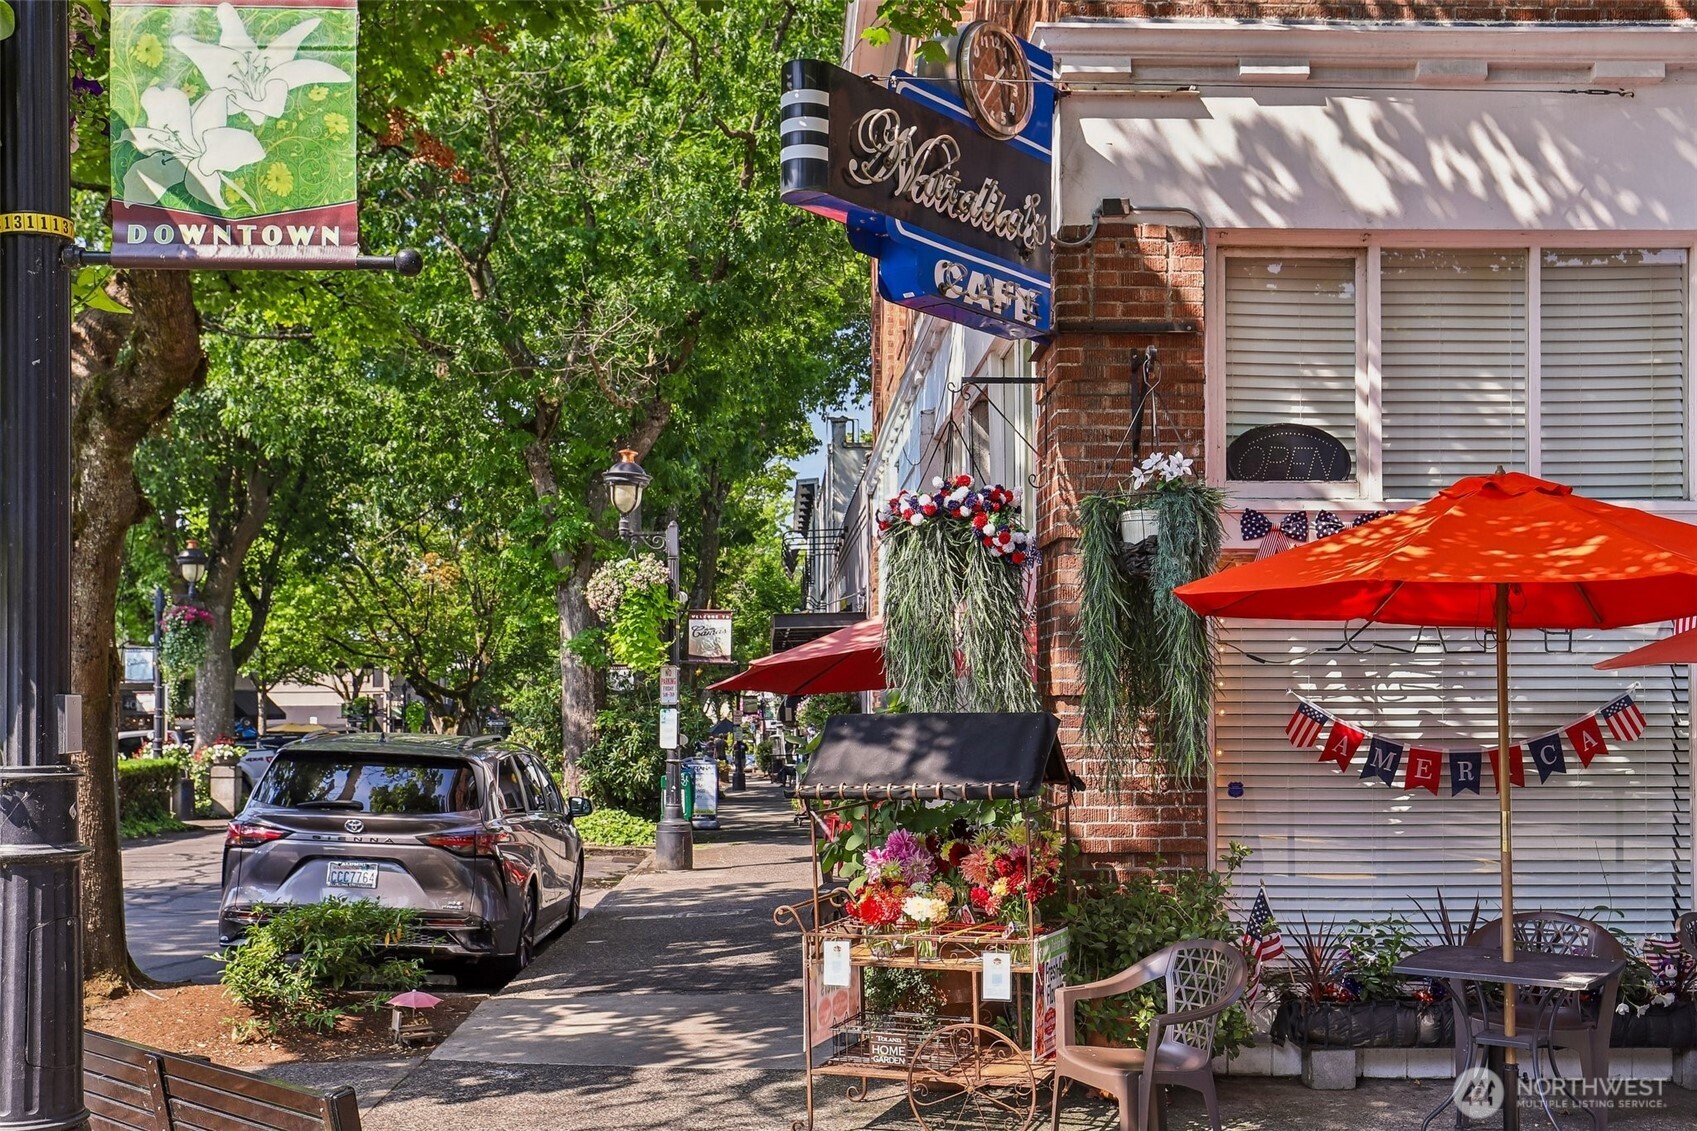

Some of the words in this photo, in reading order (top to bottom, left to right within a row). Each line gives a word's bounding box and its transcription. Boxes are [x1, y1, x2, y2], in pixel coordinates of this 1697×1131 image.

[127, 224, 340, 246] DOWNTOWN
[934, 259, 1042, 327] CAFE
[1238, 445, 1338, 480] OPEN
[1331, 729, 1598, 782] AMERCA
[312, 835, 396, 844] SIENNA
[331, 871, 375, 884] CCC7764
[871, 1044, 906, 1057] HOME
[872, 1055, 906, 1065] GARDEN
